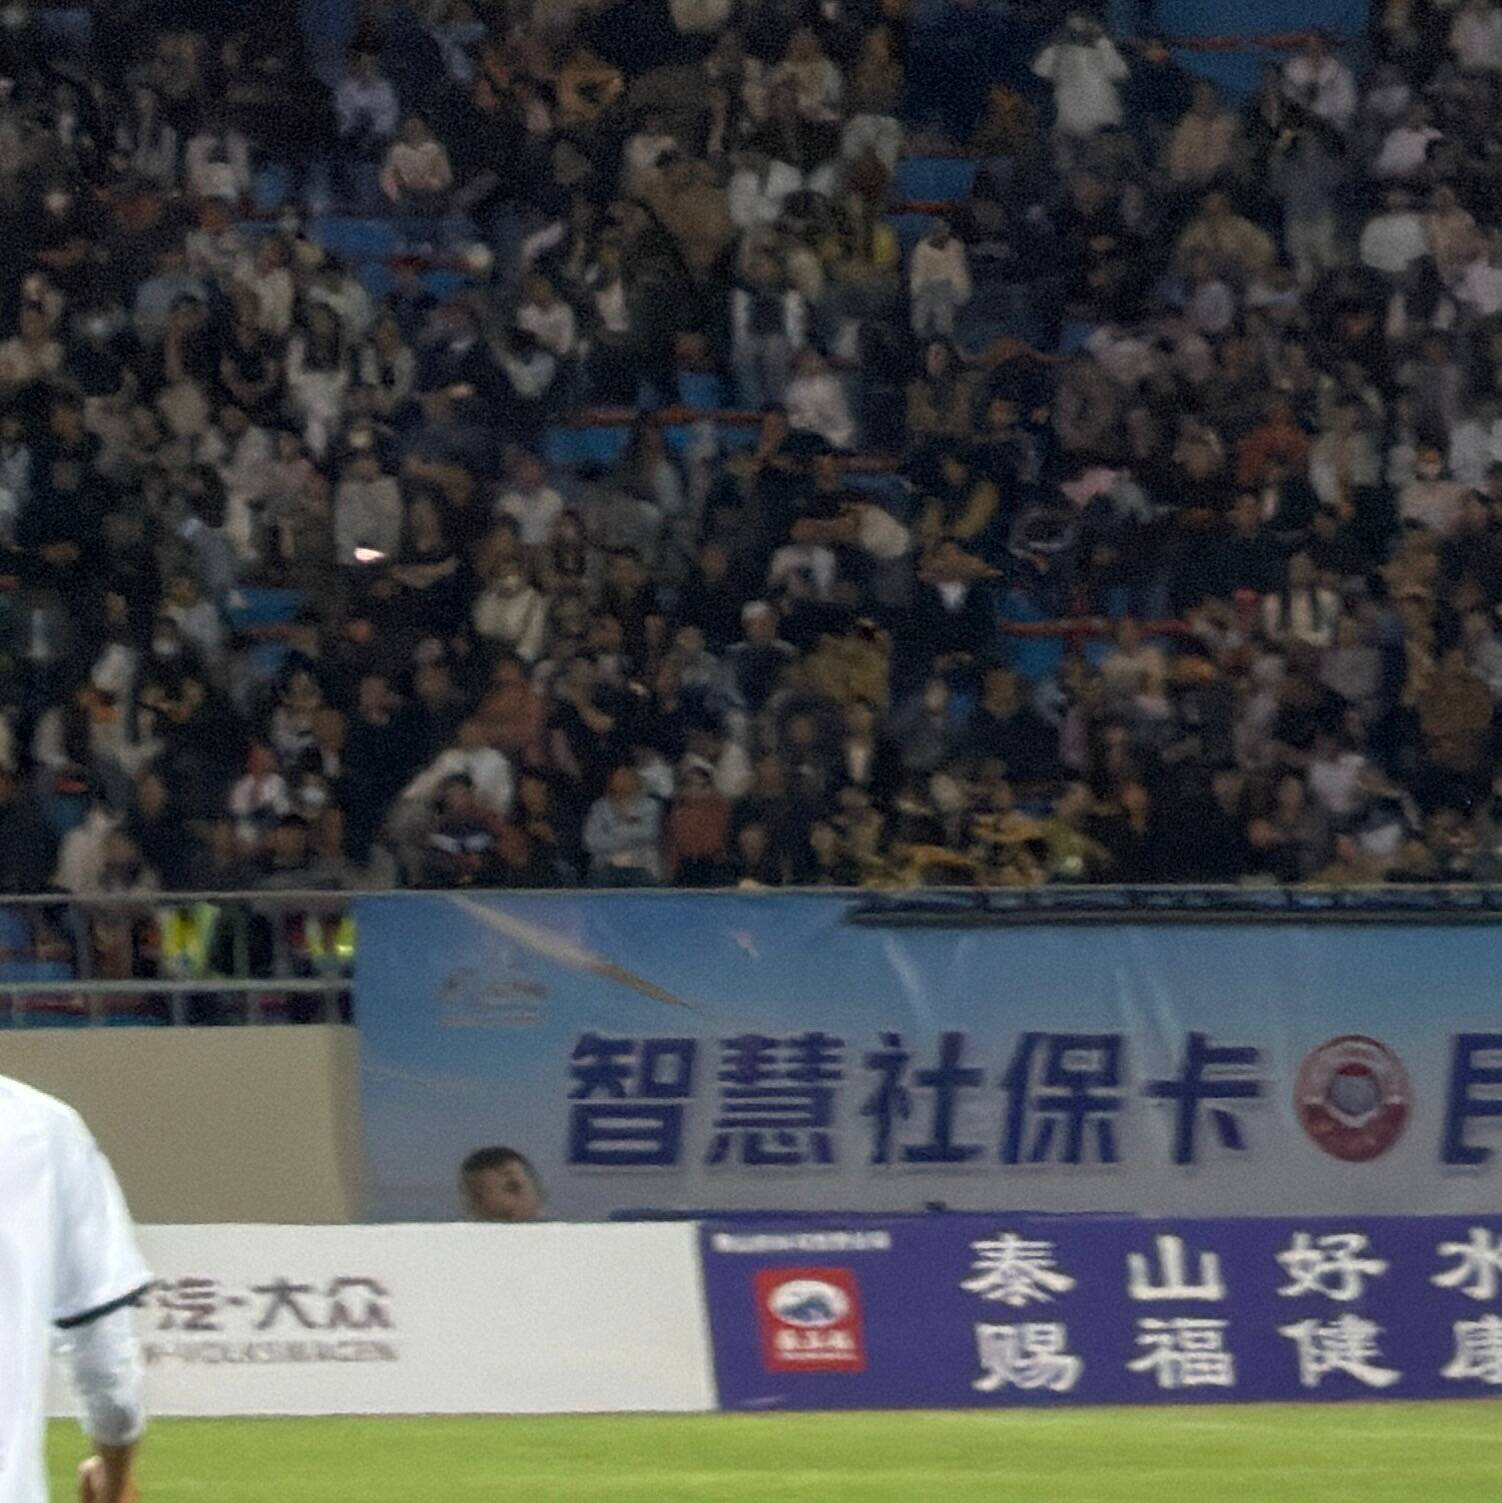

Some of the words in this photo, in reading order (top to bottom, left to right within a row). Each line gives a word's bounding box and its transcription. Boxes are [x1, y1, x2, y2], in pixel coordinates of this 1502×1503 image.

[567, 1031, 1264, 1165] 智慧社保卡
